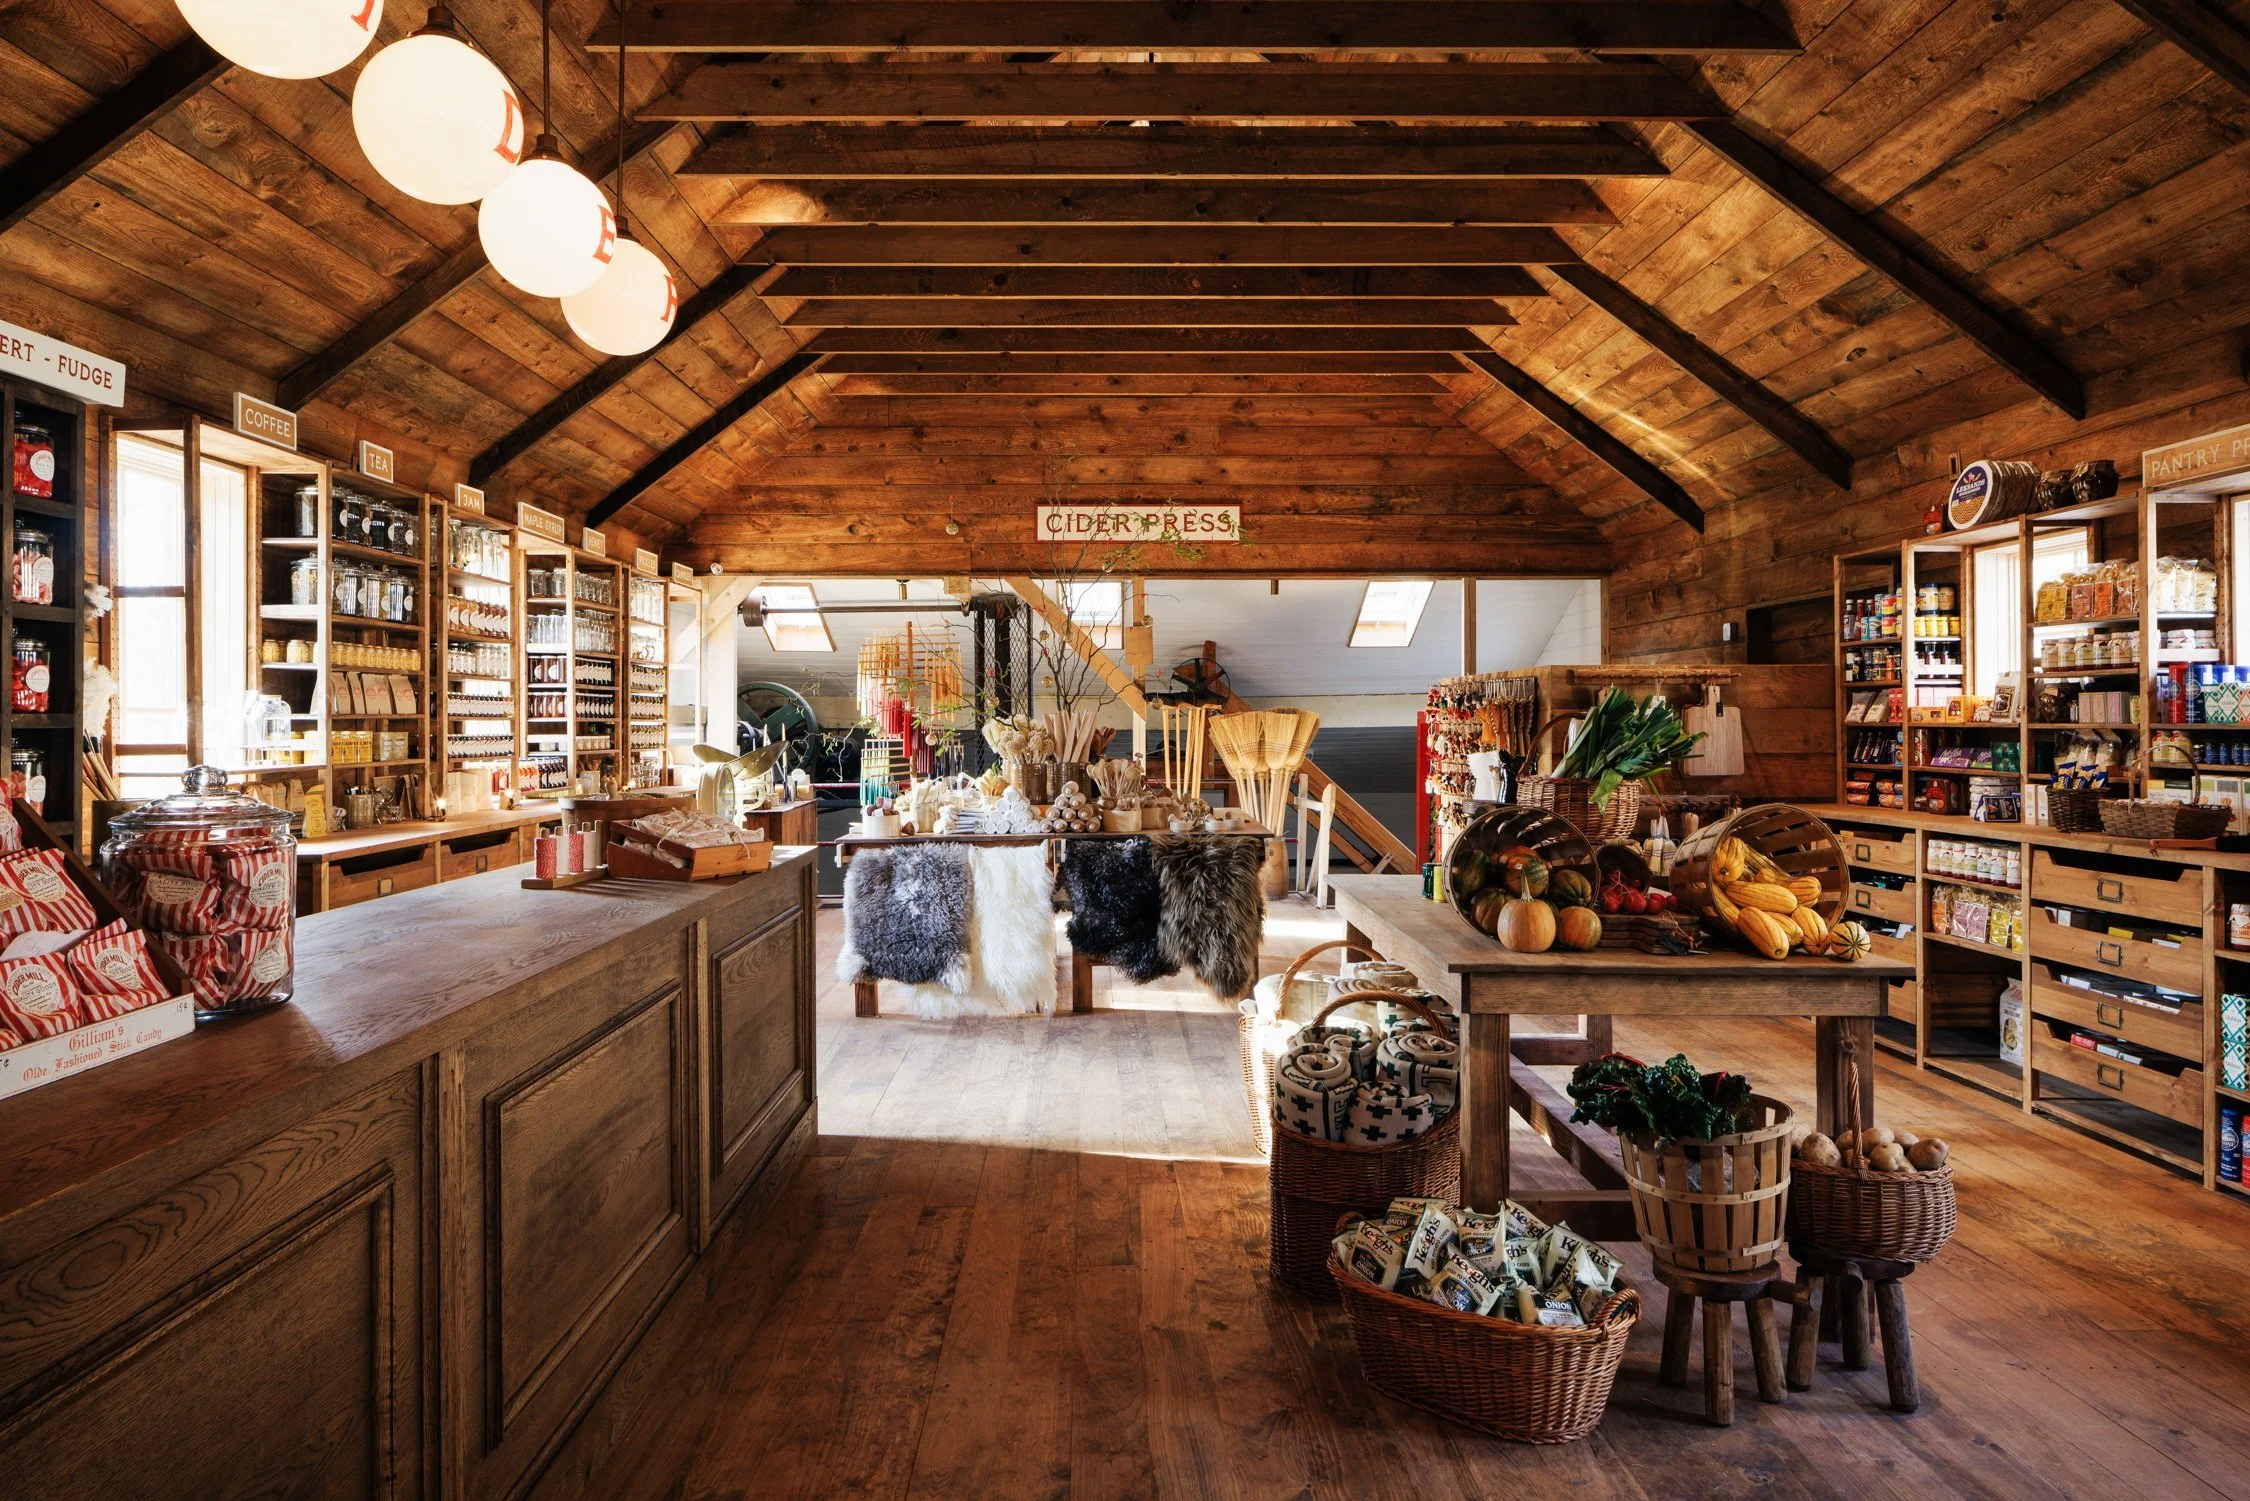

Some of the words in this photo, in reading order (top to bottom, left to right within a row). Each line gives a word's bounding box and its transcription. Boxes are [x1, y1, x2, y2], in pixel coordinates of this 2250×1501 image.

[58, 354, 113, 390] FUDGE
[245, 408, 291, 438] COFFEE
[369, 453, 389, 472] TEA
[2151, 444, 2219, 478] PANTRY
[463, 494, 481, 511] JAM
[524, 512, 544, 529] MAPLE
[545, 519, 563, 535] SYRUP
[1046, 513, 1132, 533] CIDER
[1146, 513, 1232, 533] PRESS
[28, 867, 50, 877] MILL
[109, 955, 128, 966] MILL
[12, 974, 27, 996] CIDER
[25, 972, 48, 982] MILL
[14, 991, 35, 1004] QUALITY
[36, 981, 57, 994] GOODS
[69, 1022, 124, 1051] Gilliam's
[23, 1067, 47, 1082] Olde
[54, 1047, 103, 1072] Fashioned
[108, 1039, 132, 1054] Stick
[136, 1028, 162, 1045] Candy
[1386, 1219, 1408, 1228] ONION
[1361, 1223, 1393, 1255] Keogh's
[1415, 1217, 1441, 1264] Keogh's
[1356, 1262, 1376, 1280] ONION
[1451, 1253, 1495, 1294] Keogh's
[1545, 1301, 1572, 1310] ONION
